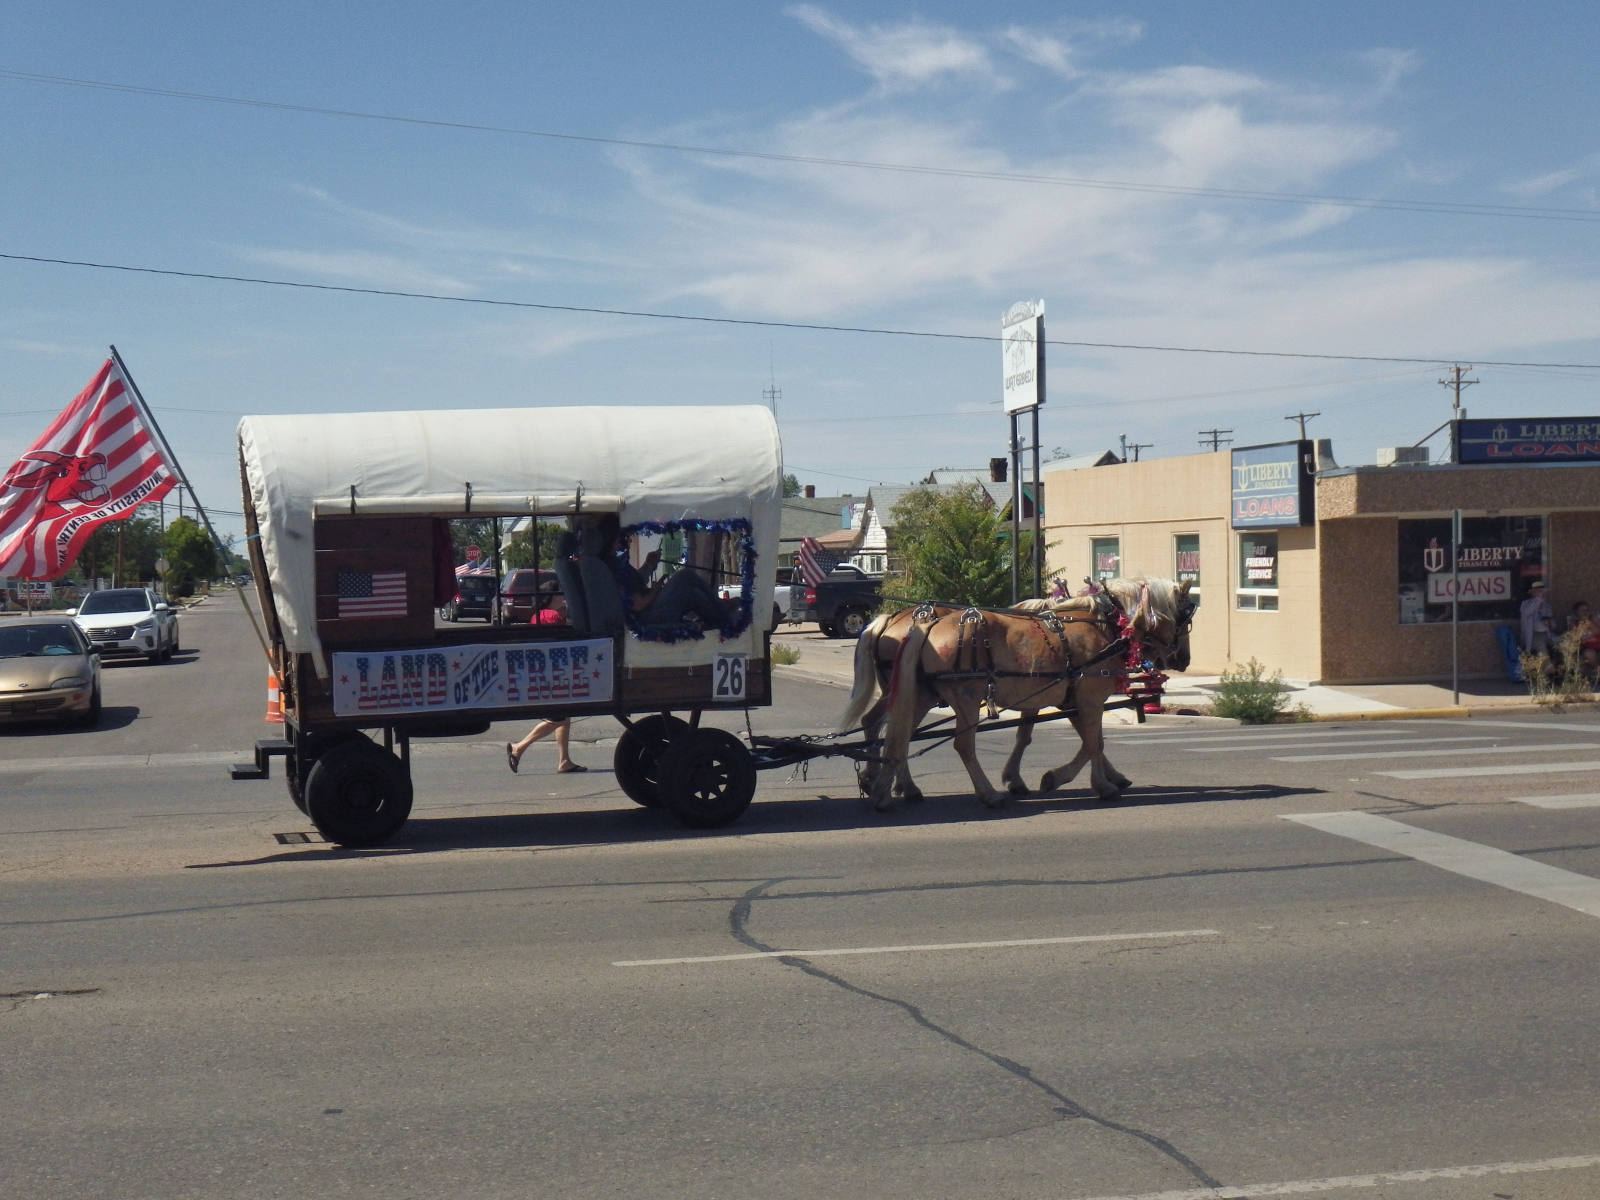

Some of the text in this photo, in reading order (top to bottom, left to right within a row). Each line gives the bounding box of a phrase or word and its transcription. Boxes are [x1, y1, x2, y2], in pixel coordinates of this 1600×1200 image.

[1250, 461, 1294, 481] LIBERTY
[1237, 497, 1296, 518] LOANS
[1434, 577, 1506, 597] LOANS
[356, 646, 590, 710] LAND OF THE FREE
[716, 658, 743, 696] 26
